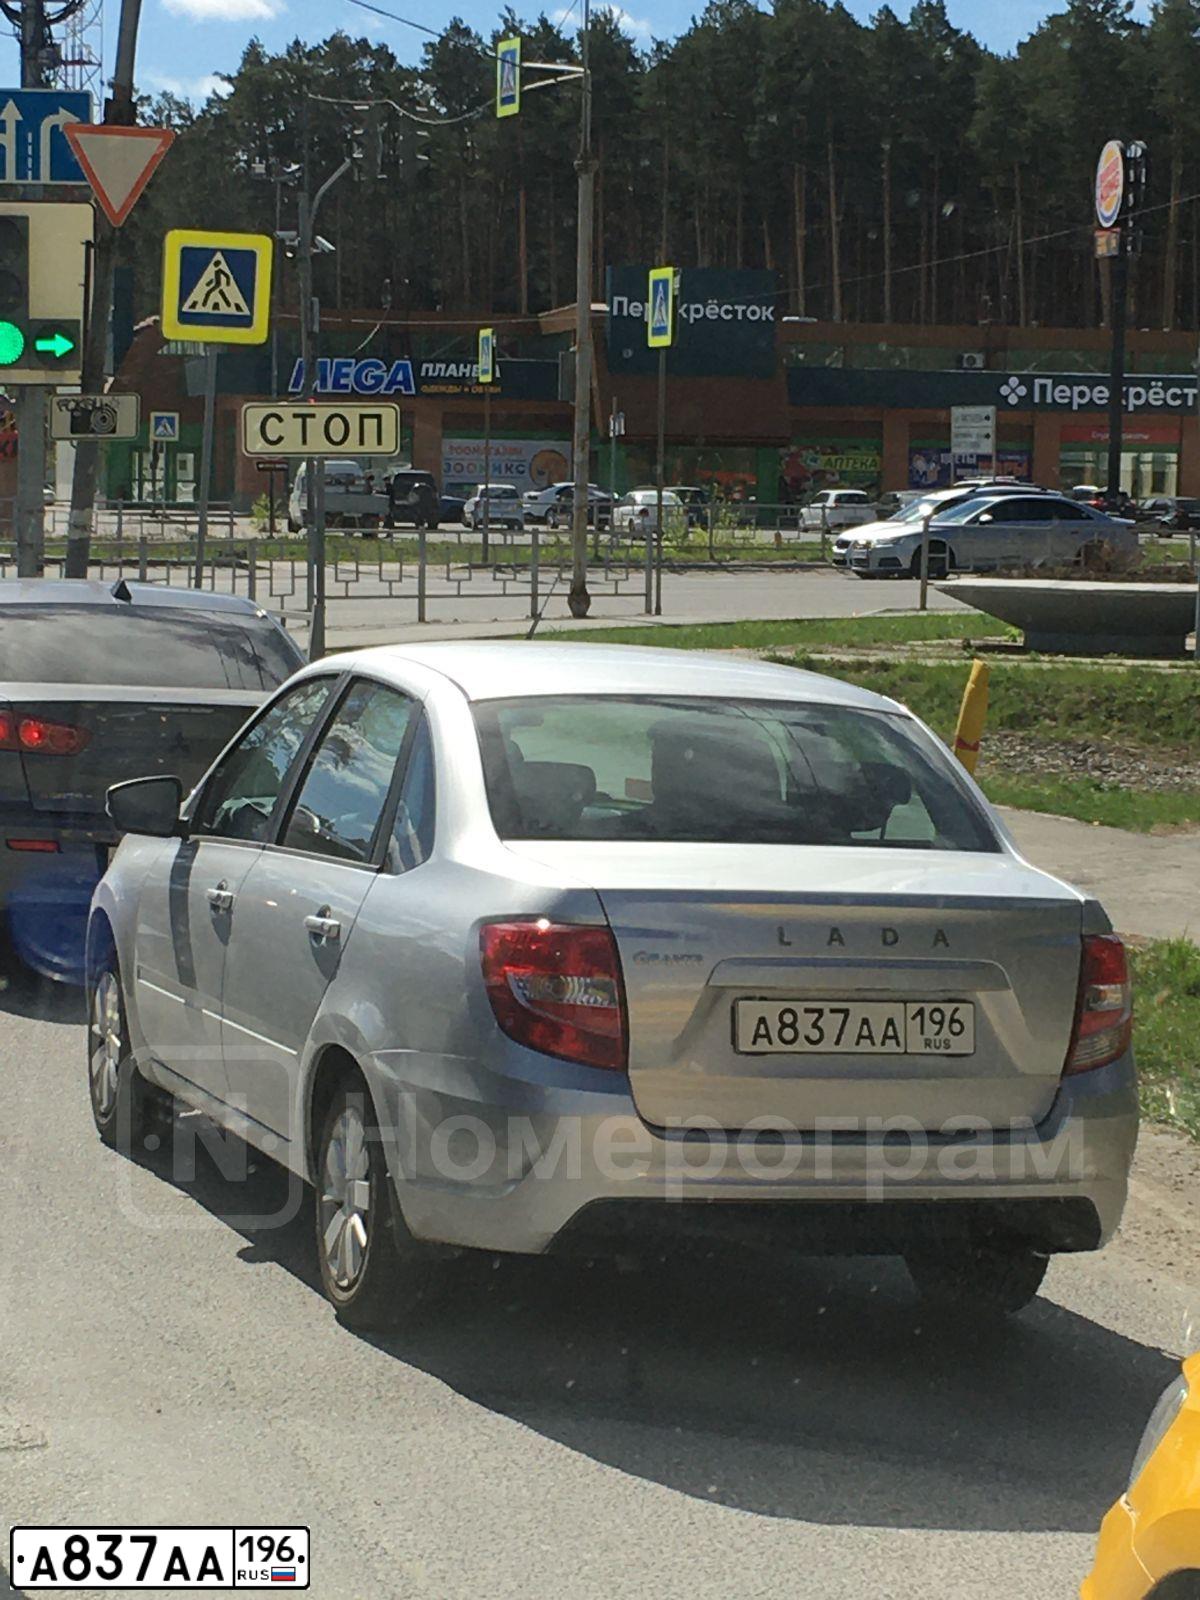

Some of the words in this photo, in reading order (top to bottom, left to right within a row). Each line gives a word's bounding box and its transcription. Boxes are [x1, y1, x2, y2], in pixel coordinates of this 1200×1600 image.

[288, 358, 416, 394] MEGA
[420, 362, 501, 378] ПЛАНЕ
[1033, 378, 1198, 411] Перерёст
[259, 412, 383, 446] СТОП
[823, 456, 878, 470] АПТЕКА
[777, 925, 950, 948] LADA
[751, 1007, 901, 1047] А837АА
[910, 1006, 965, 1037] 196
[923, 1038, 952, 1050] RUS
